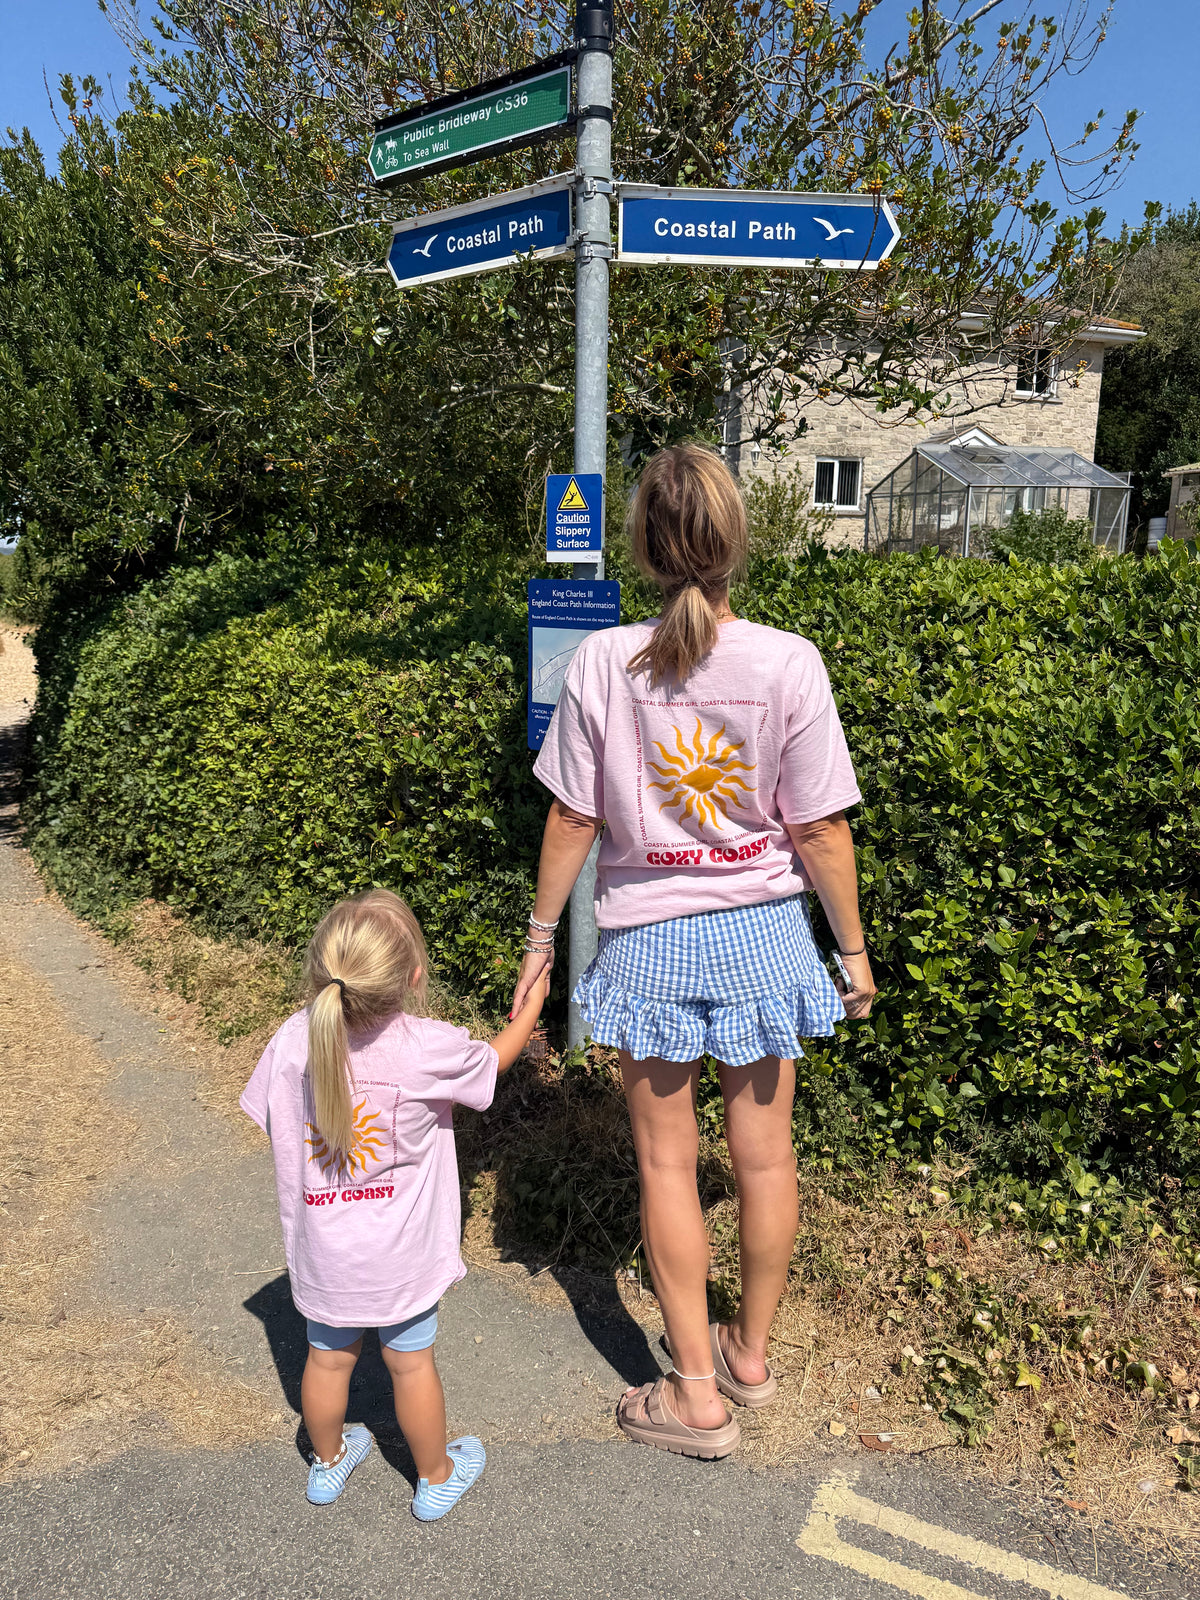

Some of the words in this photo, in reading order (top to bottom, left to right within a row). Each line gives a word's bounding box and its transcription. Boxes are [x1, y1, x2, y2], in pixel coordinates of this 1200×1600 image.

[403, 125, 434, 144] Public
[438, 104, 492, 133] Bridleway
[495, 91, 528, 114] CS36
[403, 152, 413, 163] To
[414, 147, 430, 159] Sea
[431, 139, 450, 153] Wall
[446, 224, 501, 253] Coastal
[508, 215, 544, 239] Path
[654, 217, 736, 239] Coastal
[749, 220, 796, 240] Path
[556, 513, 590, 523] Caution
[555, 526, 591, 537] Slippery
[556, 539, 590, 548] Surface
[552, 589, 564, 599] King
[565, 590, 586, 598] Charles
[531, 599, 551, 608] England
[553, 600, 568, 608] Coast
[570, 600, 582, 608] Path
[583, 601, 616, 609] Information
[632, 697, 656, 707] COASTAL
[701, 699, 727, 707] COASTAL
[756, 700, 768, 708] GIRL
[634, 720, 642, 746] SUMMER
[639, 815, 648, 841] COASTAL
[646, 848, 703, 866] COZY
[709, 835, 770, 863] COAST
[671, 840, 696, 848] SUMMER
[341, 1185, 394, 1203] COAST
